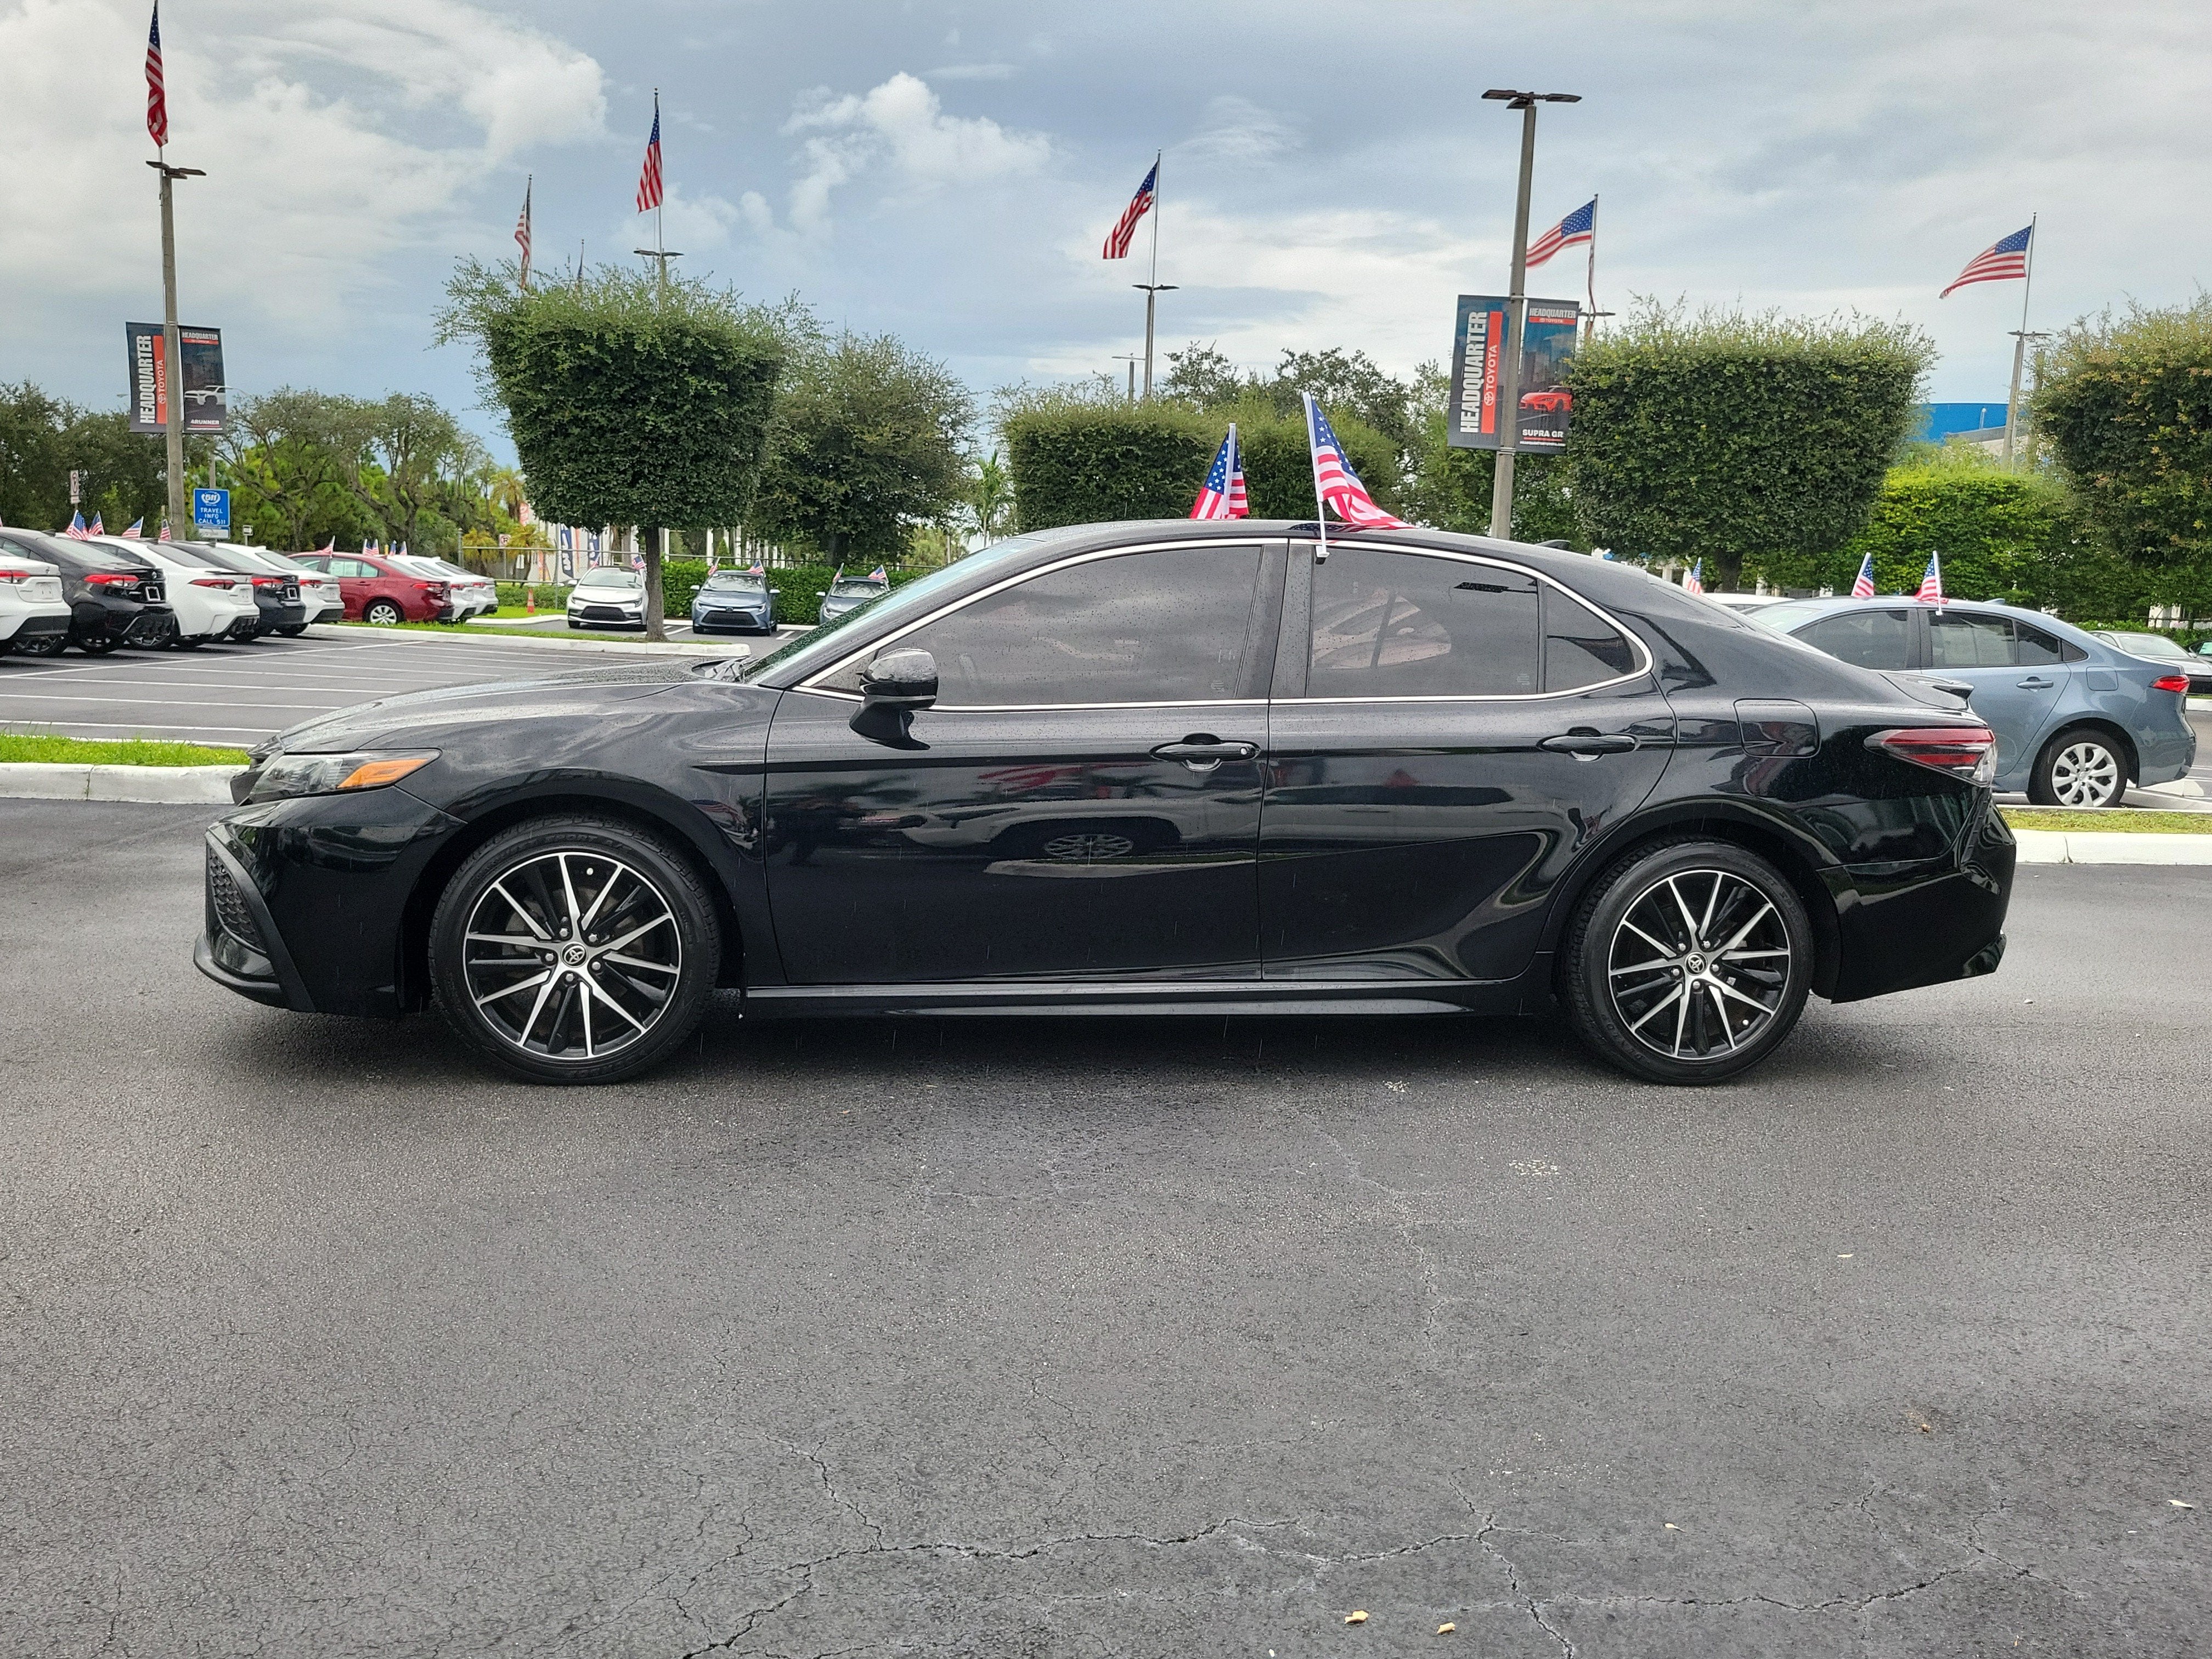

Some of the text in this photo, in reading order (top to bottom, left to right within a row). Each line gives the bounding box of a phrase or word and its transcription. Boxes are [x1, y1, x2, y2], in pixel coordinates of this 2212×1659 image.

[1529, 308, 1576, 319] HEADQUARTER
[137, 335, 156, 424] HEADQUARTER
[157, 359, 167, 392] TOYOTA
[1460, 311, 1487, 433] HEADQUARTER
[1486, 345, 1498, 391] TOYOTA
[1522, 428, 1550, 437] SUPRA
